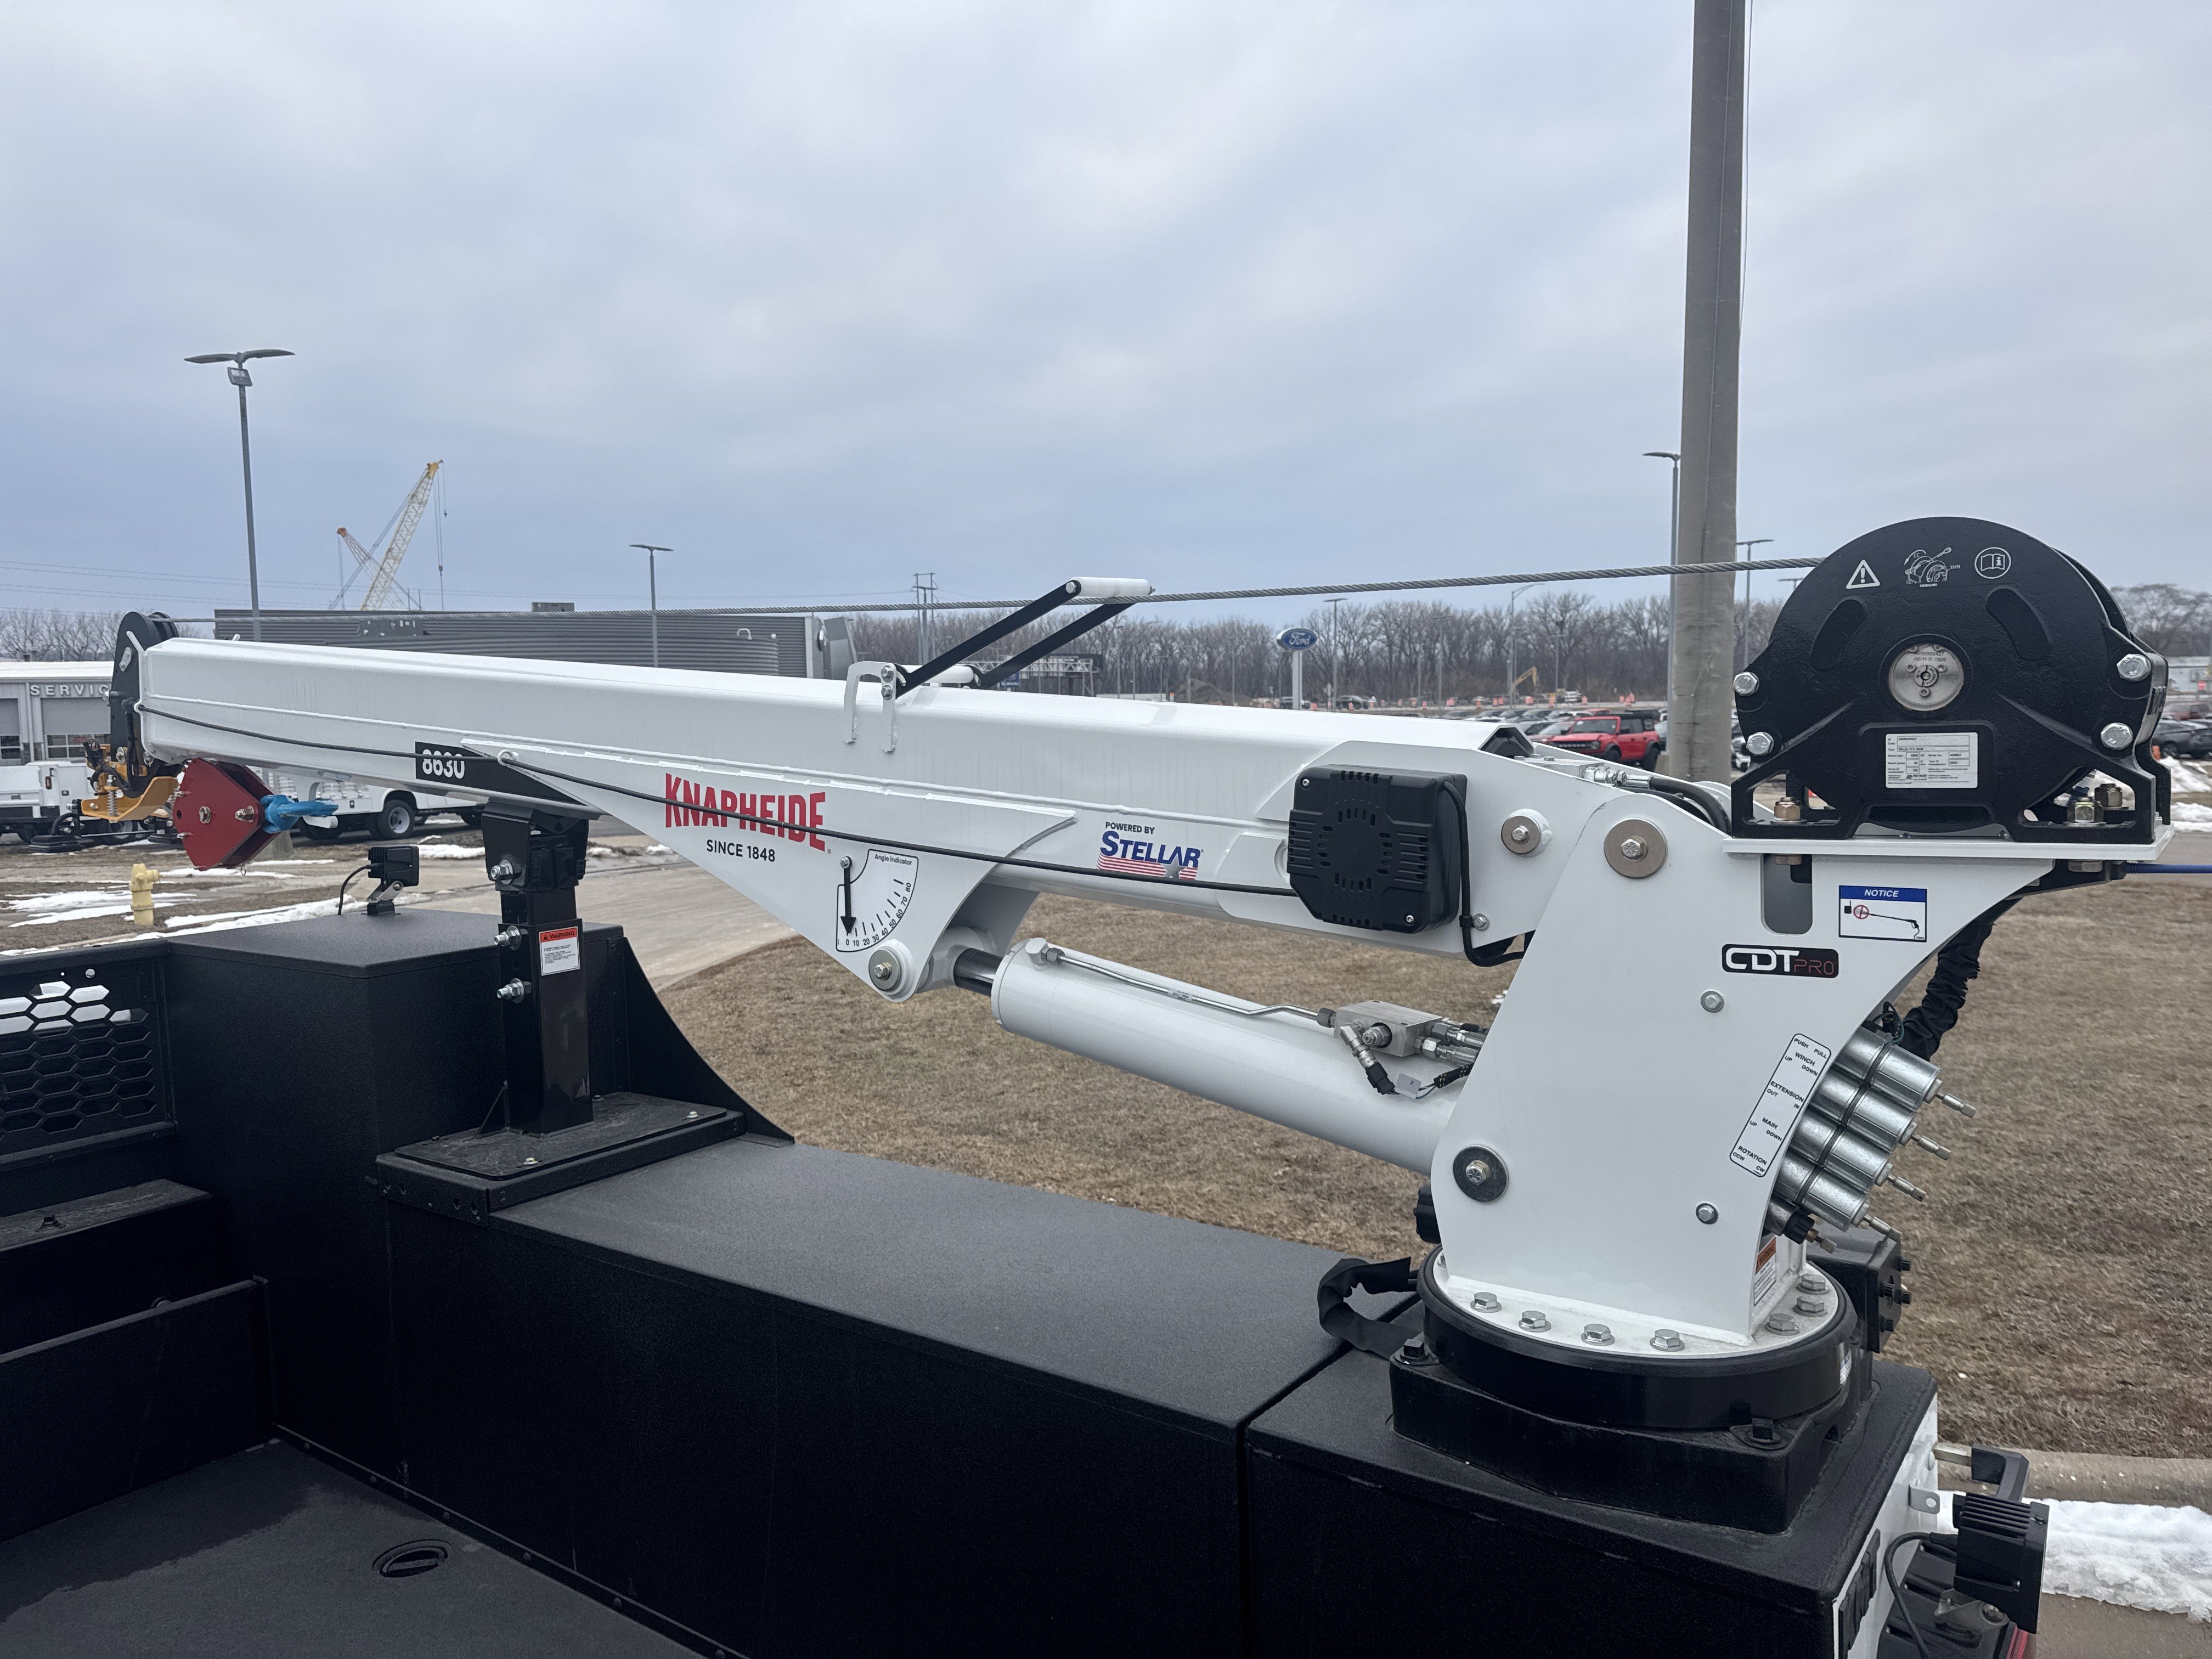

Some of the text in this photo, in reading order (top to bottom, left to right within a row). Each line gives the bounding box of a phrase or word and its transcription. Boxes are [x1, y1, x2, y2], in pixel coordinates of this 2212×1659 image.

[1289, 632, 1311, 645] Ford
[30, 685, 110, 696] SERVIC
[422, 749, 465, 779] 8630
[665, 772, 826, 852] KNAPHEIDE
[1105, 821, 1155, 834] POWERED BY
[707, 839, 775, 862] SINCE 1848
[1100, 831, 1201, 868] STELLAR
[875, 854, 912, 865] Angle Indicator
[1864, 889, 1899, 898] NOTICE
[872, 934, 879, 943] 30
[881, 927, 888, 936] 40
[889, 919, 896, 928] 50
[896, 909, 903, 919] 60
[901, 896, 907, 906] 70
[905, 882, 911, 893] 80
[1794, 958, 1835, 975] PRO
[1794, 1038, 1827, 1059] PUSH PULL
[1795, 1052, 1815, 1066] WINCH
[1801, 1064, 1818, 1076] DOWN
[1767, 1088, 1779, 1097] OUT
[1770, 1081, 1804, 1102] EXTENSION
[1762, 1117, 1778, 1129] MAIN
[1766, 1130, 1782, 1141] DOWN
[1733, 1152, 1745, 1161] CCW
[1738, 1146, 1767, 1165] ROTATION
